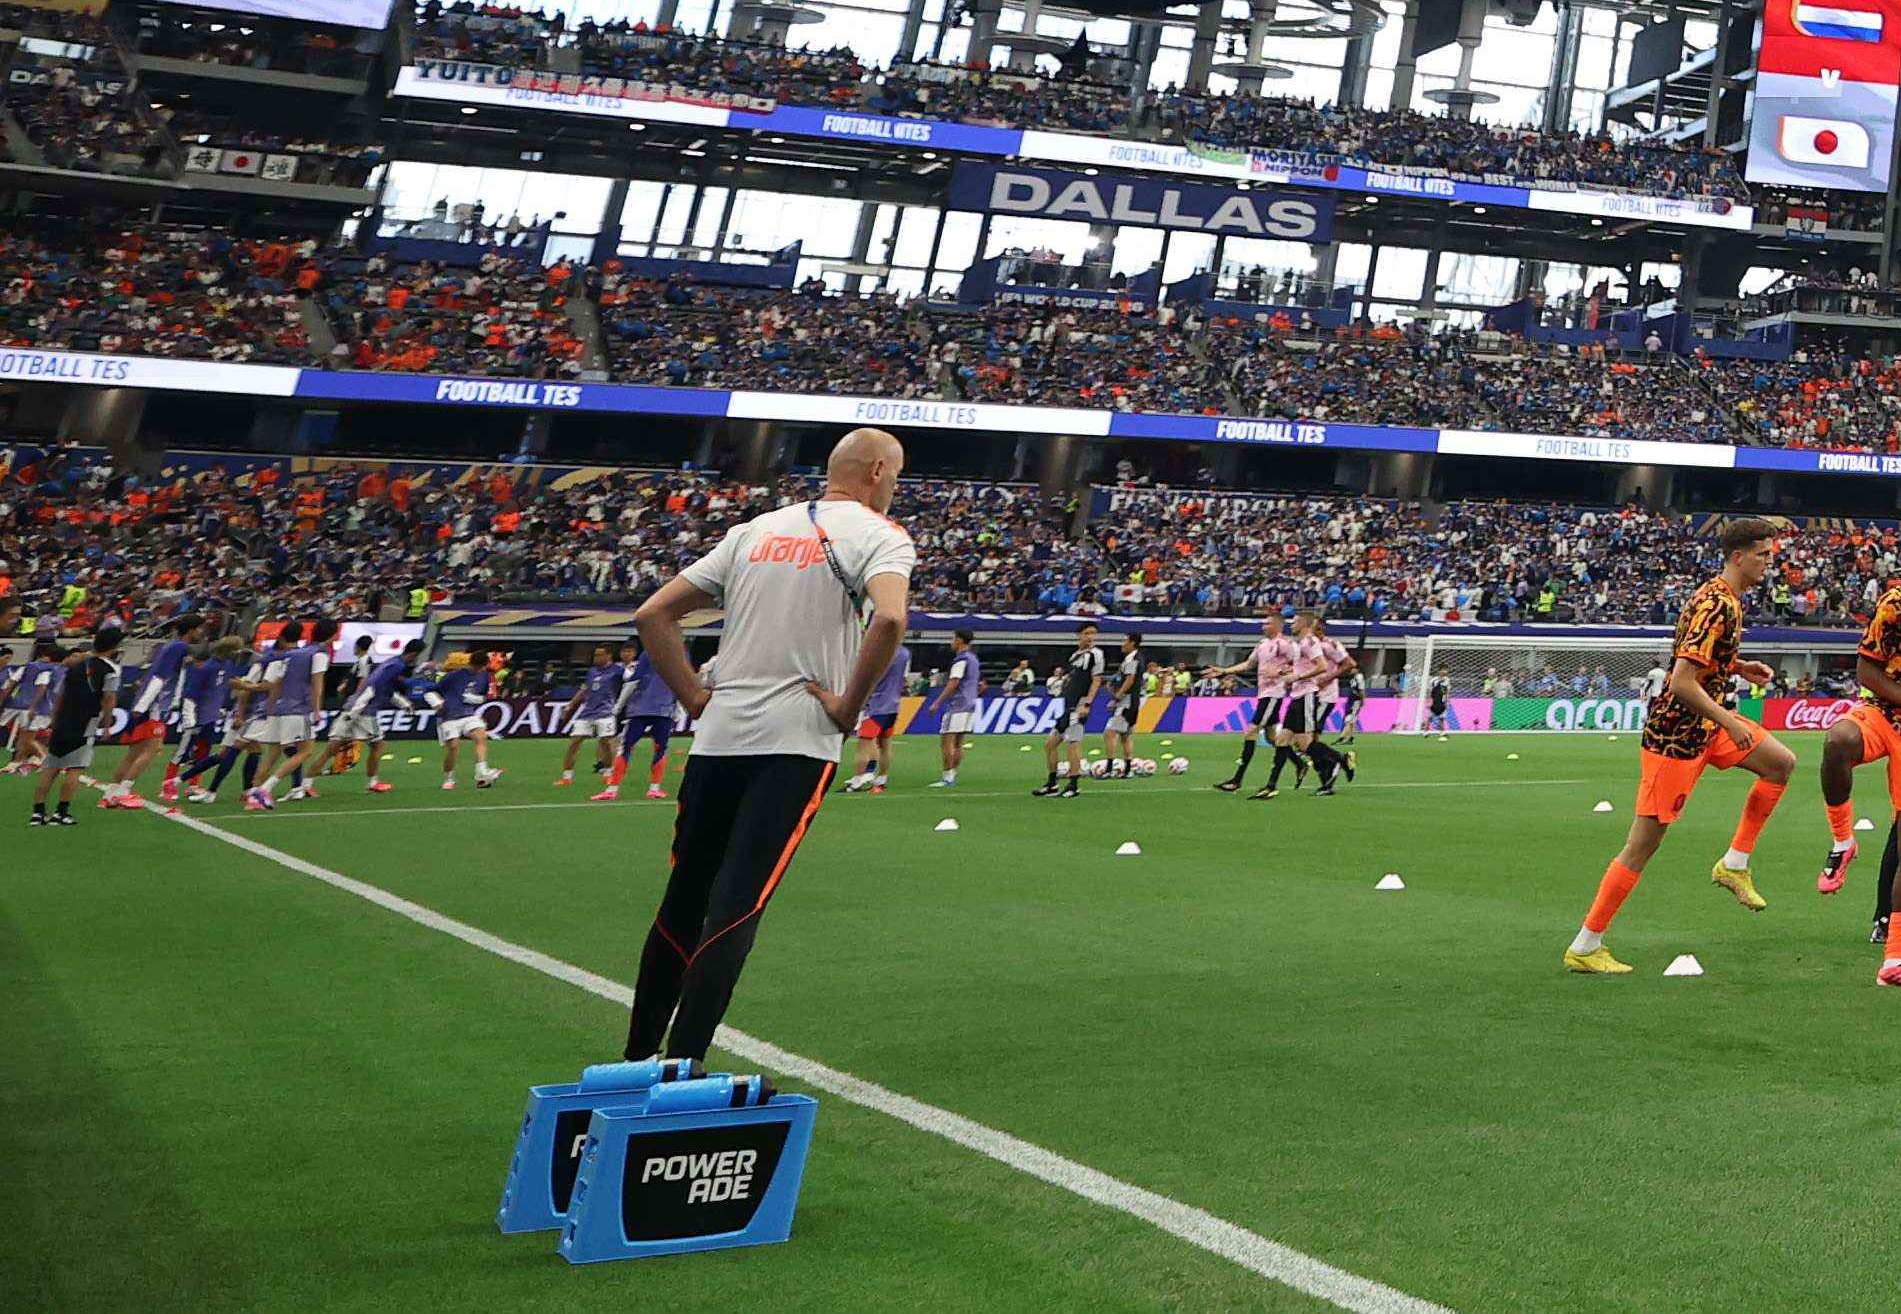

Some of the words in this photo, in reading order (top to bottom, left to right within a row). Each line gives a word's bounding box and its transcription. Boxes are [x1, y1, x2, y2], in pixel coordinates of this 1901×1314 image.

[823, 115, 891, 138] FOOTBALL
[1109, 145, 1168, 166] FOOTBALL
[1366, 171, 1421, 193] FOOTBALL
[988, 172, 1319, 240] DALLAS
[1602, 199, 1654, 216] FOOTBALL
[1023, 292, 1072, 307] WOLD
[436, 377, 542, 404] FOOTBALL
[856, 402, 940, 422] FOOTBALL
[1217, 420, 1297, 443] FOOTBALL
[1536, 441, 1599, 458] FOOTBALL
[1819, 453, 1879, 471] FOOTBALL
[971, 696, 1067, 735] VISA
[641, 1149, 758, 1184] POWER
[687, 1174, 753, 1205] ADE
